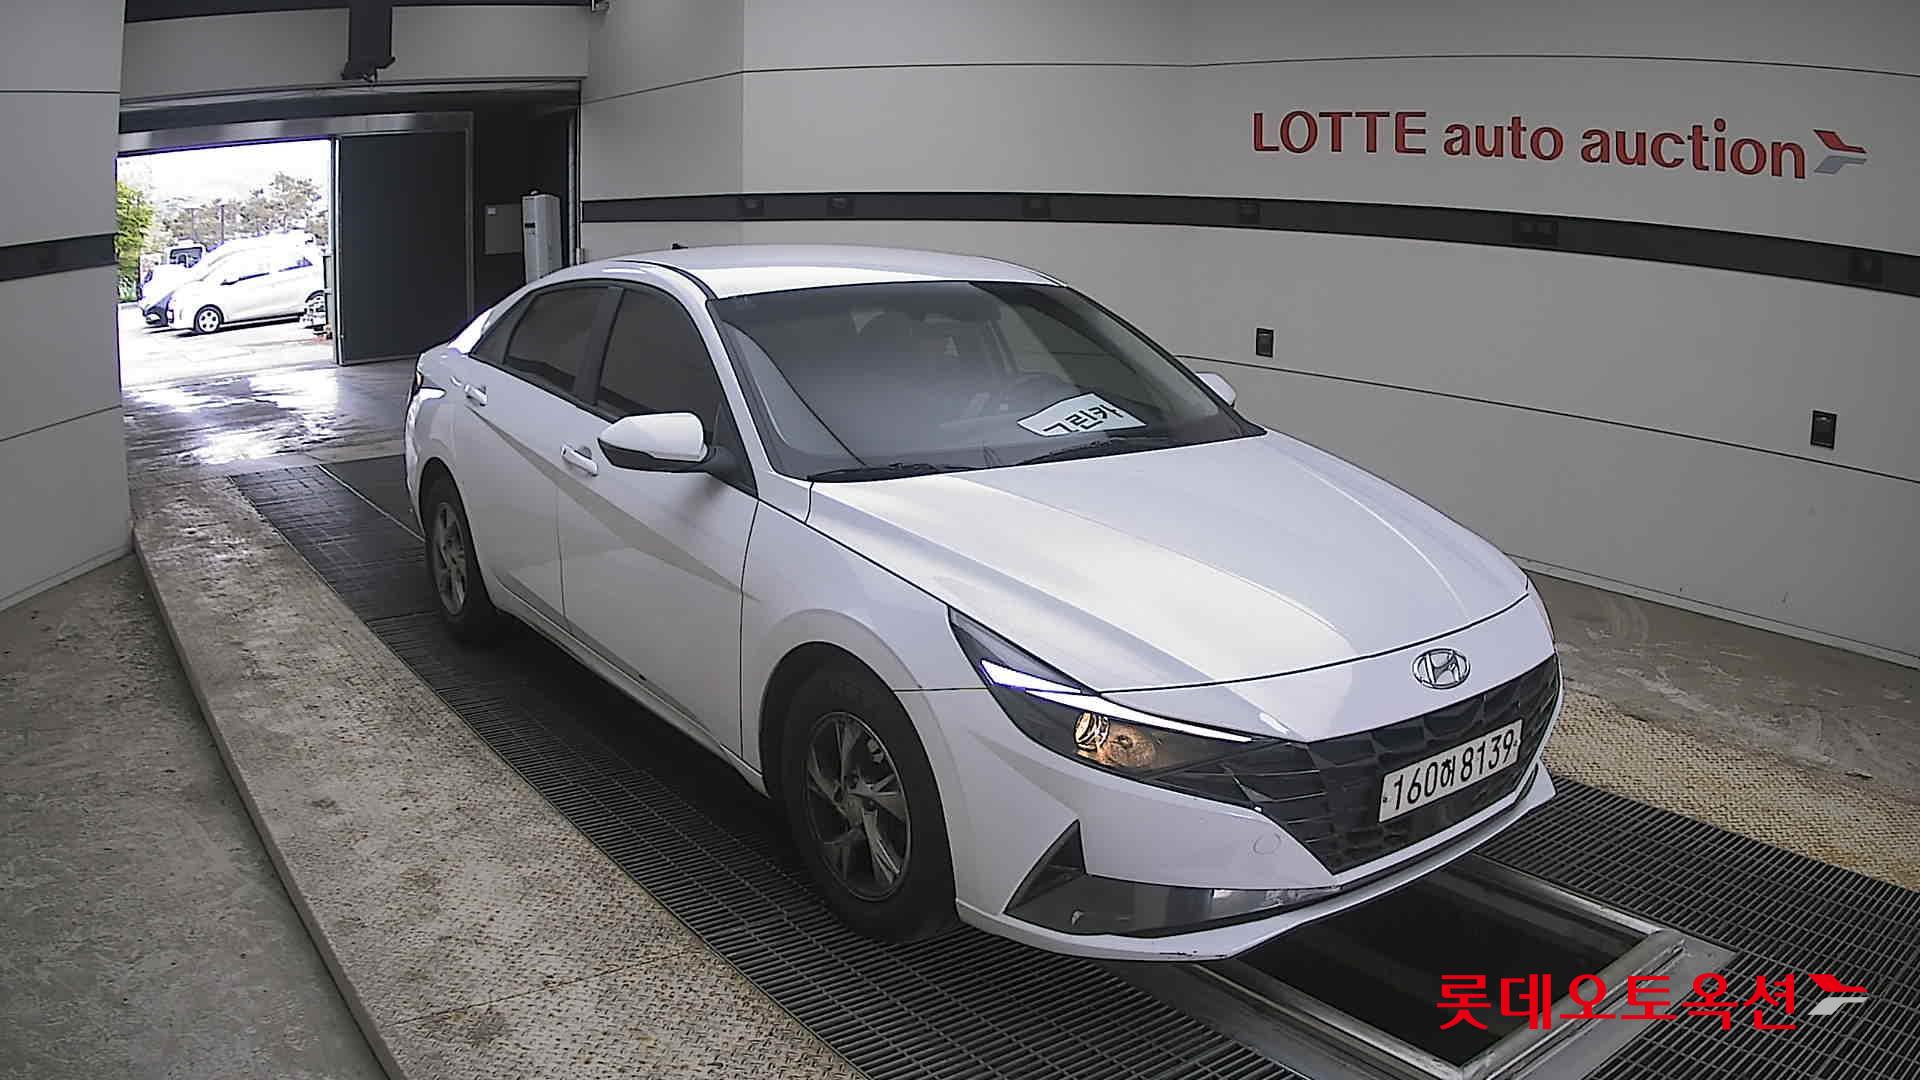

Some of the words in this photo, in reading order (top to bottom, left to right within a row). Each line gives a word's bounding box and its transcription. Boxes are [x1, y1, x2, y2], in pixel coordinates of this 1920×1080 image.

[1252, 111, 1426, 154] LOTTE
[1444, 116, 1565, 161] auto
[1581, 118, 1806, 179] auction
